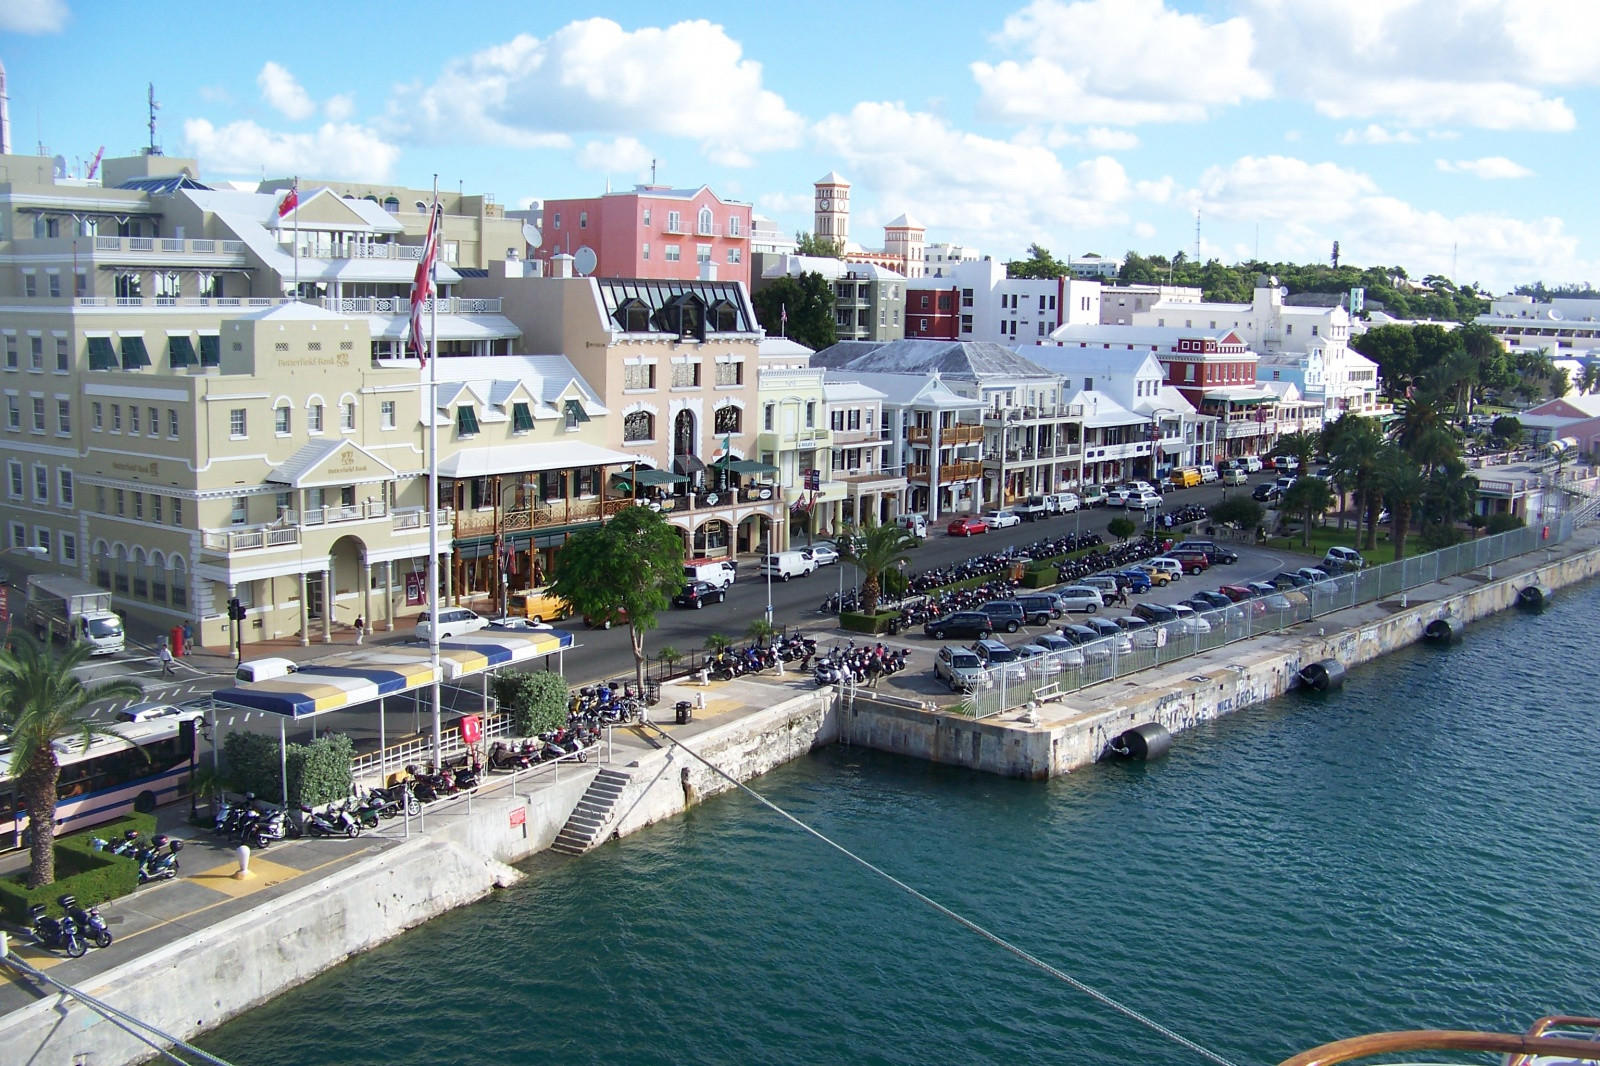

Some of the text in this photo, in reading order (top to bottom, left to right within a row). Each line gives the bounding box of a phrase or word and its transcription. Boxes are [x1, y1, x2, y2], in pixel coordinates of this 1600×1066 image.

[277, 357, 336, 367] Butterfield Bank
[328, 466, 355, 474] Butterfield
